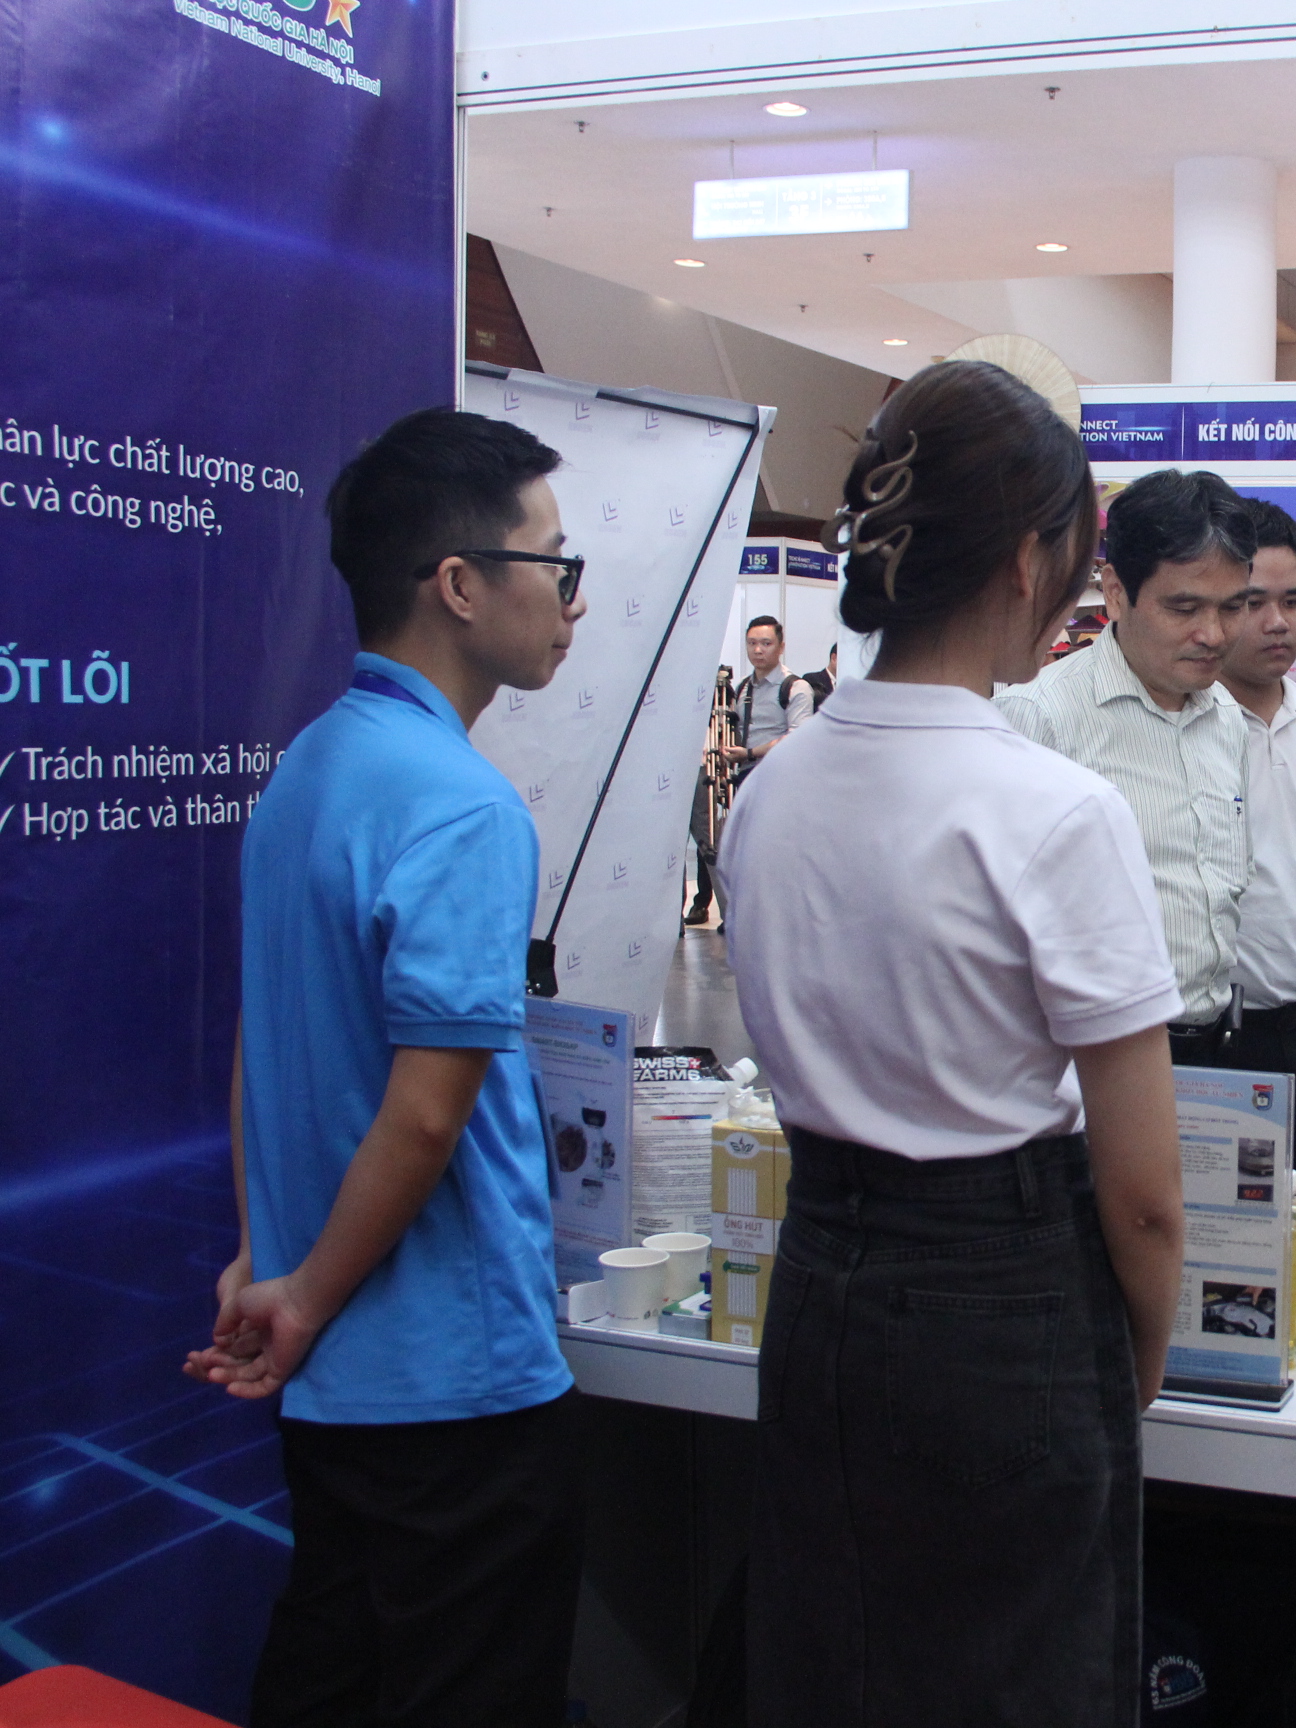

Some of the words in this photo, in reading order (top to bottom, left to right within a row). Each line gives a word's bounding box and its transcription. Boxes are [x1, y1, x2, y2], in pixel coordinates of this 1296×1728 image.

[174, 0, 229, 33] Vietnam
[231, 16, 283, 56] National
[284, 40, 345, 85] University,
[346, 67, 381, 97] Hanoi
[283, 17, 309, 44] GIA
[309, 28, 328, 53] HÀ
[329, 37, 354, 64] NỘI
[1111, 431, 1164, 442] VIETNAM
[1198, 418, 1226, 442] KẾT
[1232, 417, 1260, 442] NỐI
[0, 418, 42, 456] ân
[53, 424, 100, 468] lực
[109, 436, 170, 474] chất
[179, 444, 255, 493] lượng
[262, 466, 304, 498] cao,
[24, 478, 60, 512] và
[70, 484, 141, 529] công
[150, 495, 222, 537] nghệ,
[748, 554, 768, 565] 155
[61, 649, 129, 704] LÕI
[22, 746, 103, 781] Trách
[113, 745, 194, 784] nhiệm
[201, 744, 231, 775] xã
[239, 743, 271, 780] hội
[23, 801, 89, 842] Hợp
[98, 798, 141, 831] tác
[149, 795, 178, 828] và
[187, 794, 240, 826] thân
[633, 1057, 689, 1069] SWISS
